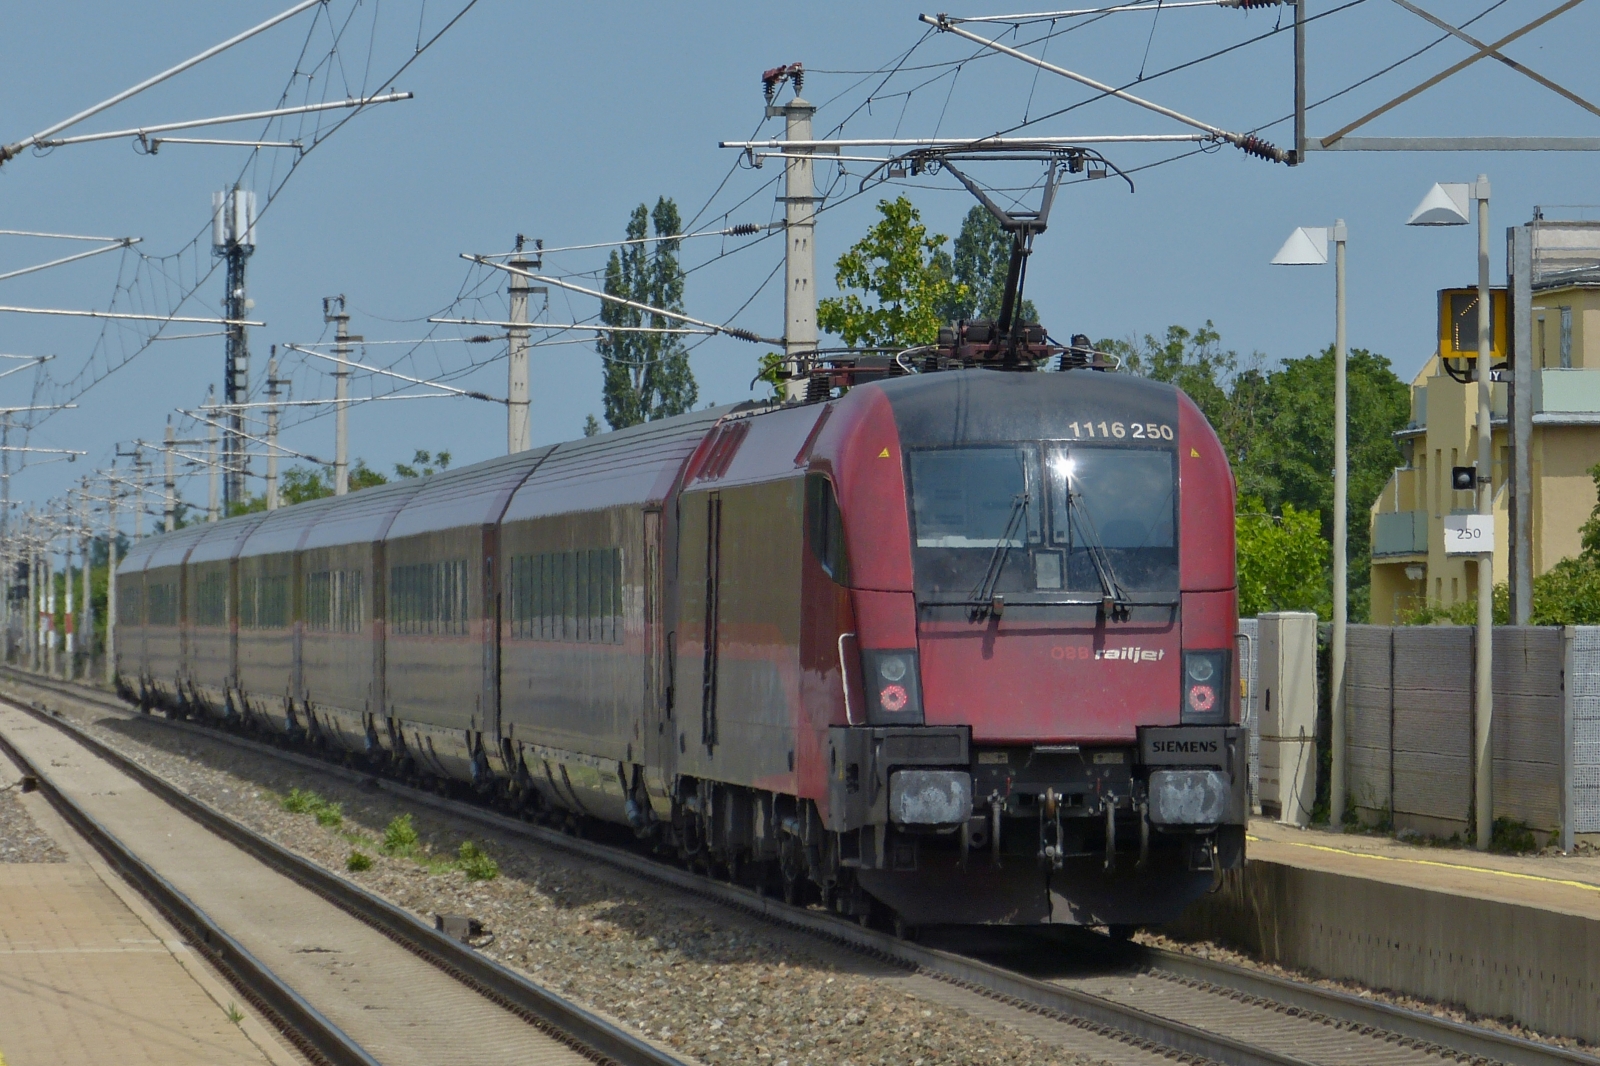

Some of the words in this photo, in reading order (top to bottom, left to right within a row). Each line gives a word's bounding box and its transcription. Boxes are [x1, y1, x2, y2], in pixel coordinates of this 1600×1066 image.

[1069, 421, 1126, 438] 1116
[1130, 422, 1174, 440] 250
[1457, 528, 1481, 540] 250
[1095, 646, 1164, 663] railjet
[1152, 740, 1217, 753] SIEMENS
